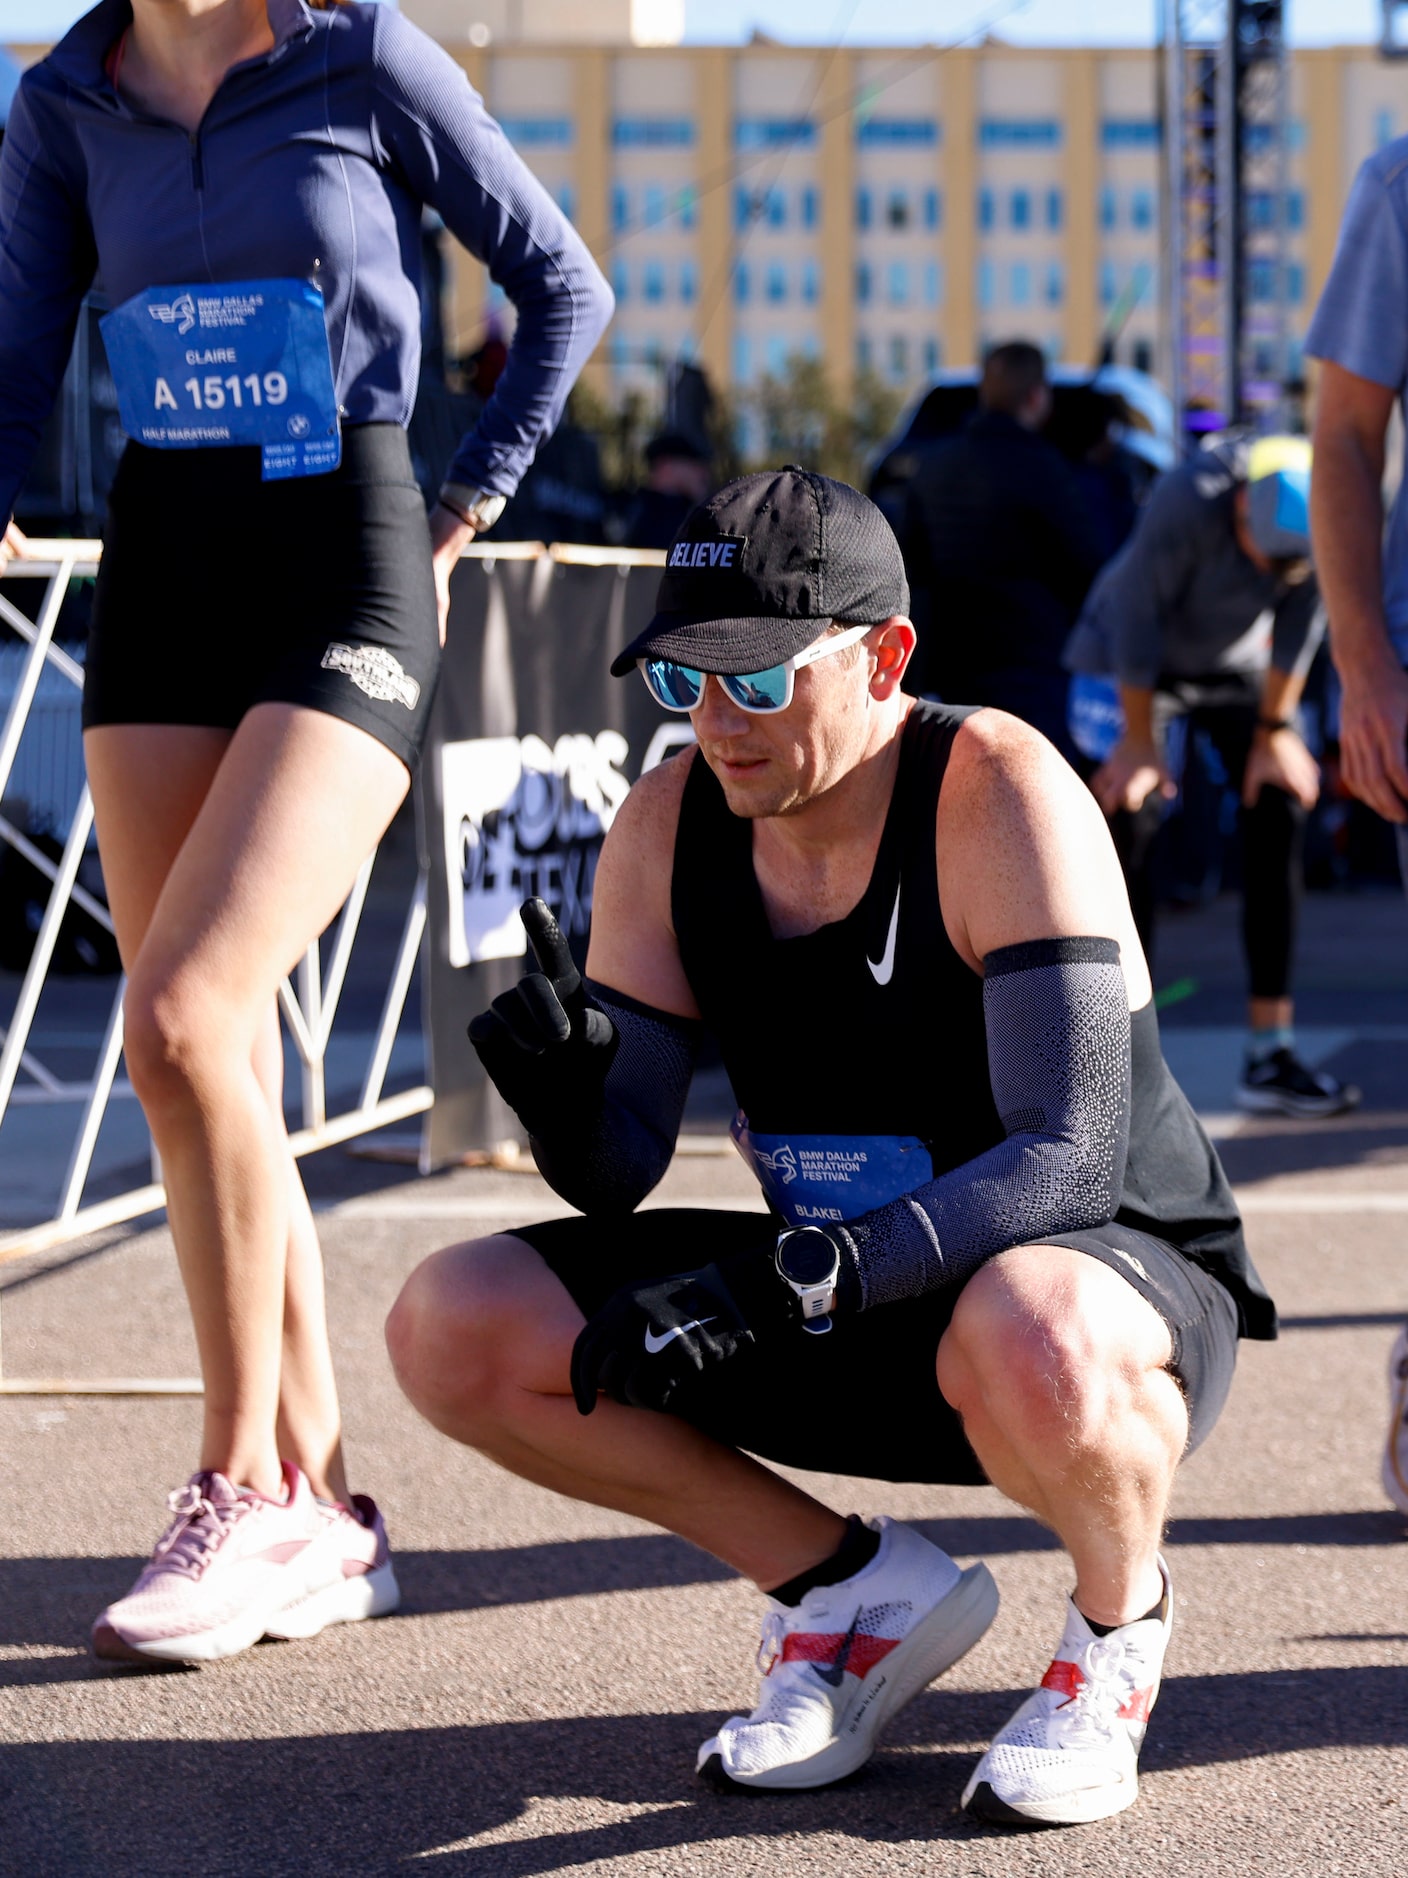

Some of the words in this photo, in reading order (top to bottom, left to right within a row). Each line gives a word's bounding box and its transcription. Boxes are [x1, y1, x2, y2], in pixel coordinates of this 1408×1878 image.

[186, 348, 237, 365] CLAIRE
[154, 377, 178, 410] A
[185, 371, 288, 410] 15119
[142, 427, 166, 440] HALF
[167, 426, 230, 440] MARATHON
[669, 542, 737, 567] BELIEVE
[799, 1151, 825, 1161] BMW
[826, 1151, 868, 1162] DALLAS
[801, 1161, 860, 1172] MARATHON
[803, 1171, 852, 1182] FESTIVAL
[794, 1204, 843, 1221] BLAKE!
